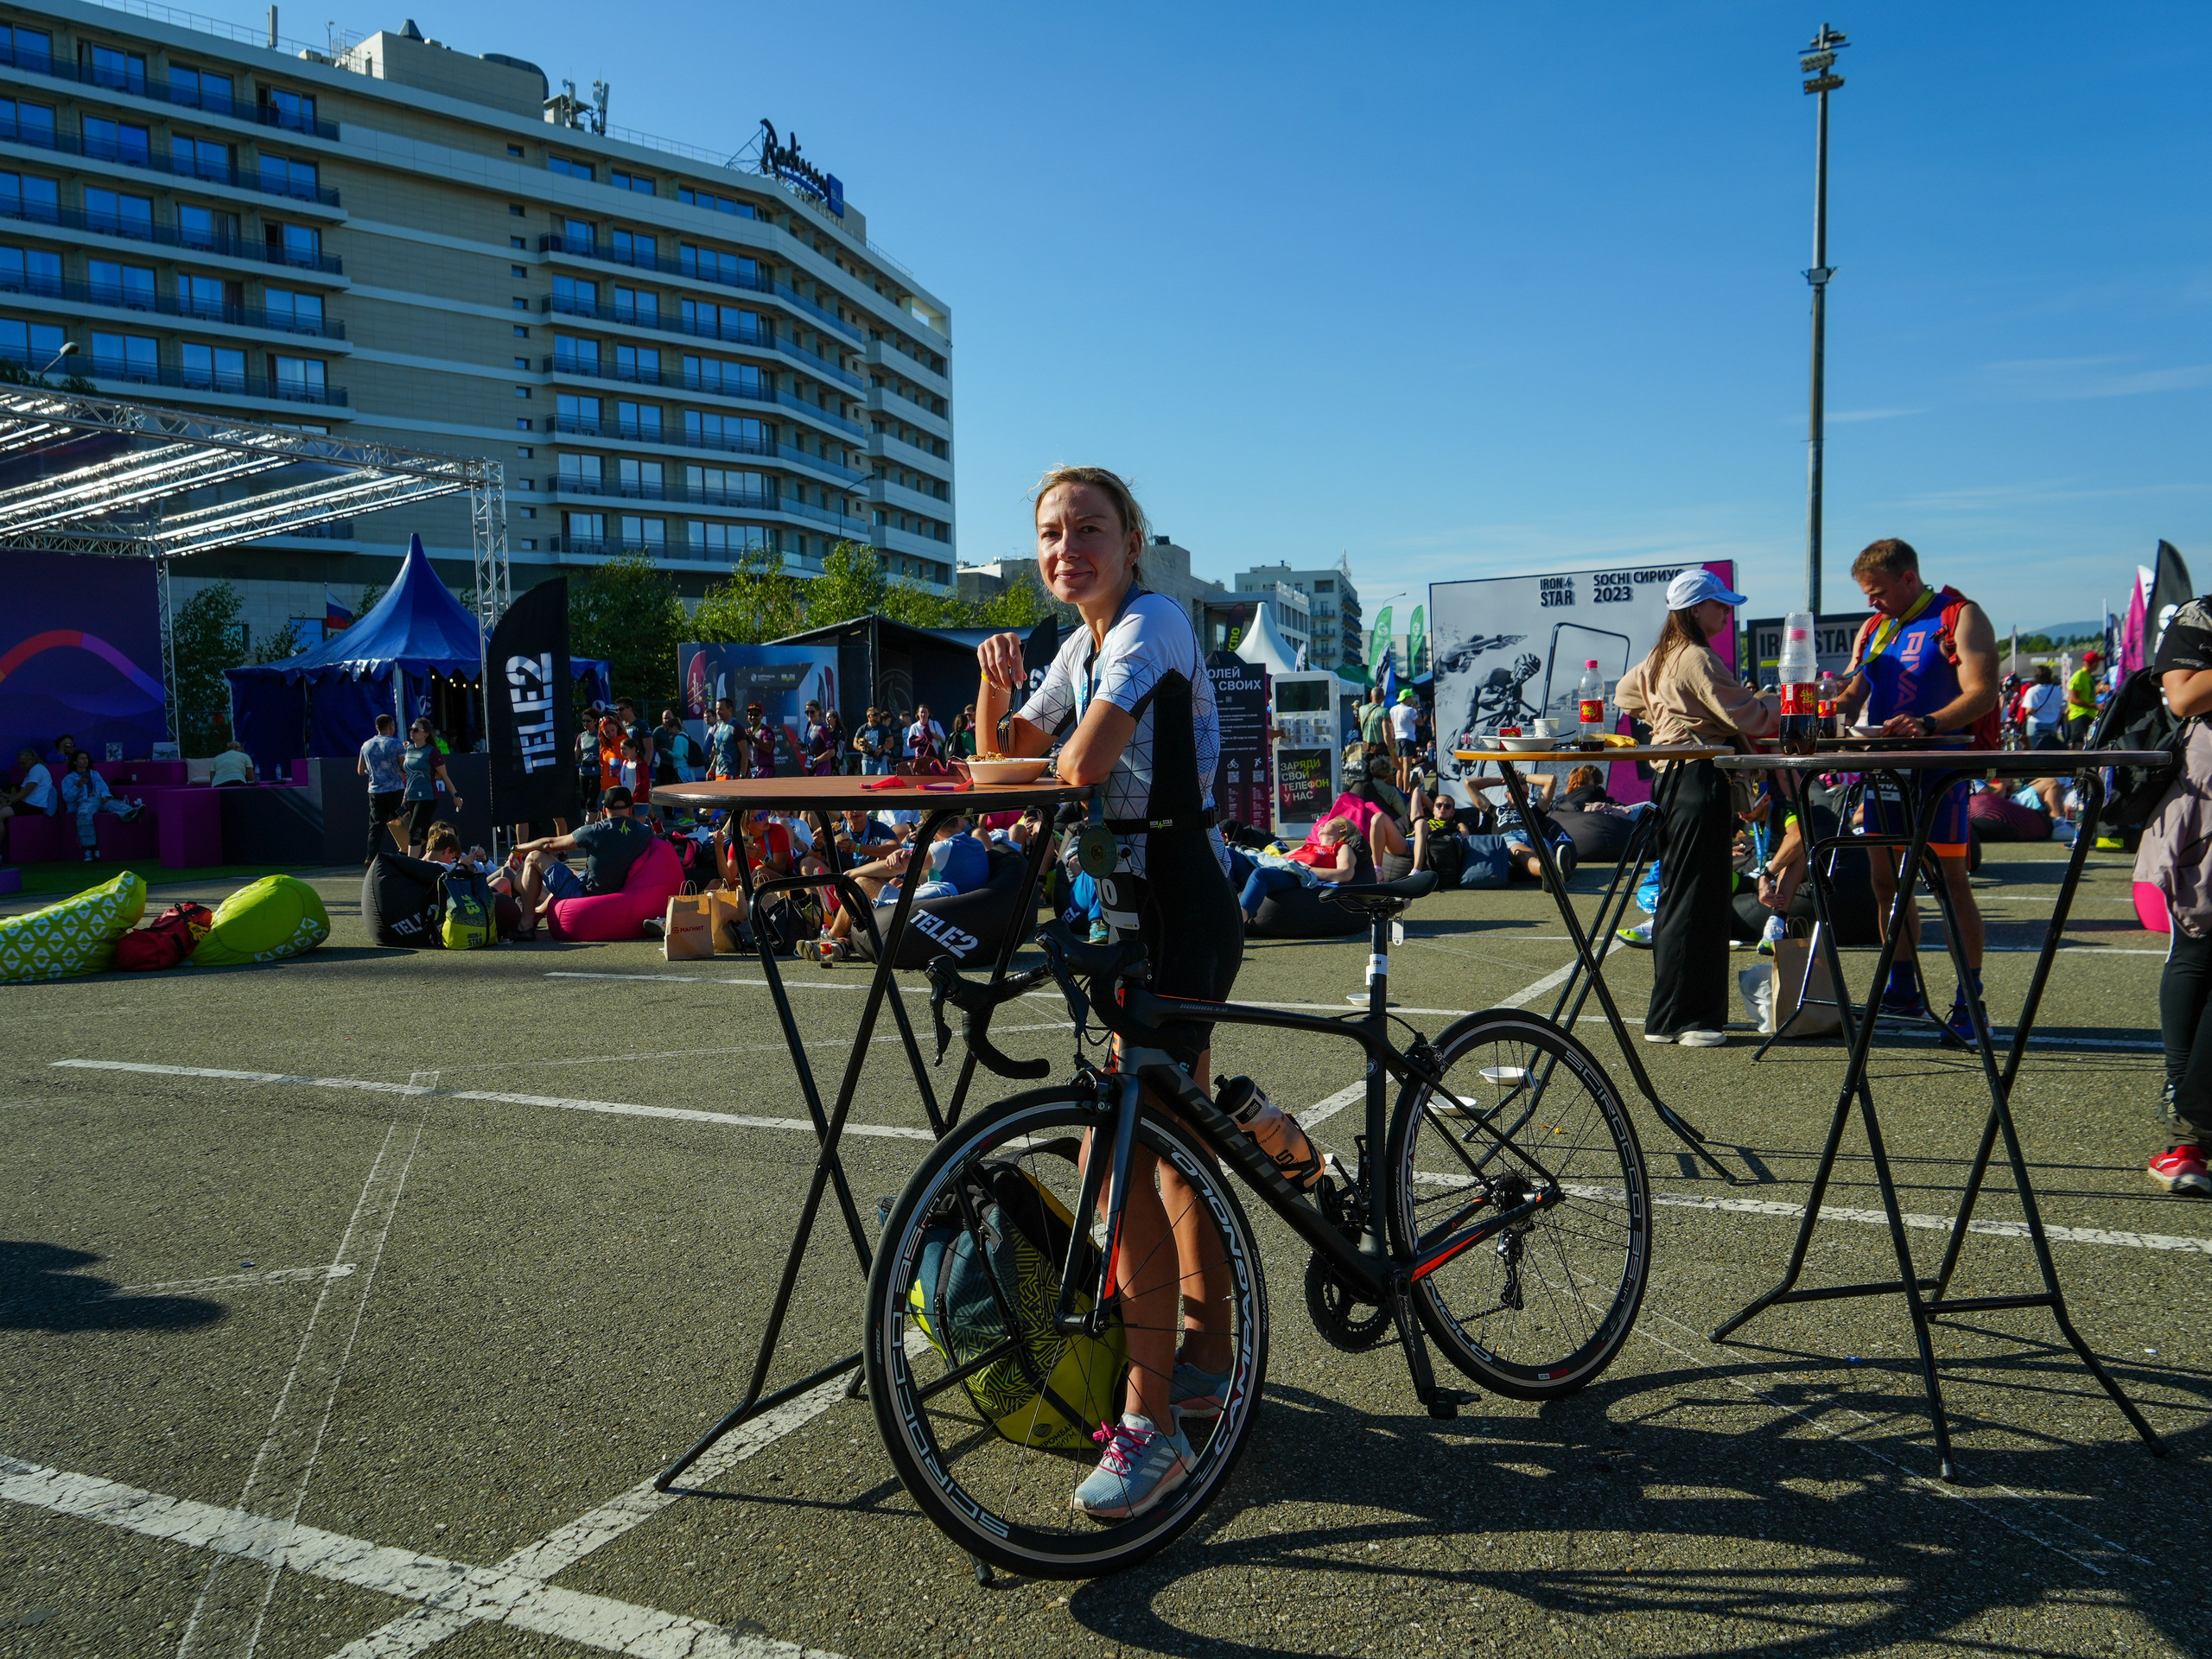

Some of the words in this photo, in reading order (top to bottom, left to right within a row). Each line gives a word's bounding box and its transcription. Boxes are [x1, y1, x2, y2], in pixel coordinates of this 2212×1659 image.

[1540, 577, 1563, 590] IRON
[1593, 572, 1630, 586] SOCHI
[1541, 590, 1574, 607] STAR
[1593, 587, 1632, 603] 2023
[1760, 632, 1781, 657] IR
[1207, 666, 1241, 679] ОЛЕЙ
[1893, 631, 1926, 715] RIVA
[1218, 680, 1262, 690] СВОИХ
[505, 652, 556, 773] TELE2
[1280, 758, 1321, 772] ЗАРЯДИ
[1281, 768, 1310, 782] СВОЙ
[1282, 779, 1330, 792] ТЕЛЕФОН
[1284, 793, 1291, 803] У
[1293, 791, 1314, 801] НАС
[910, 909, 978, 959] TELE2
[1565, 1050, 1642, 1218] SCIROCCO
[1171, 1151, 1253, 1456] CAMPAGNOLO
[892, 1312, 1010, 1539] SCIROCCO
